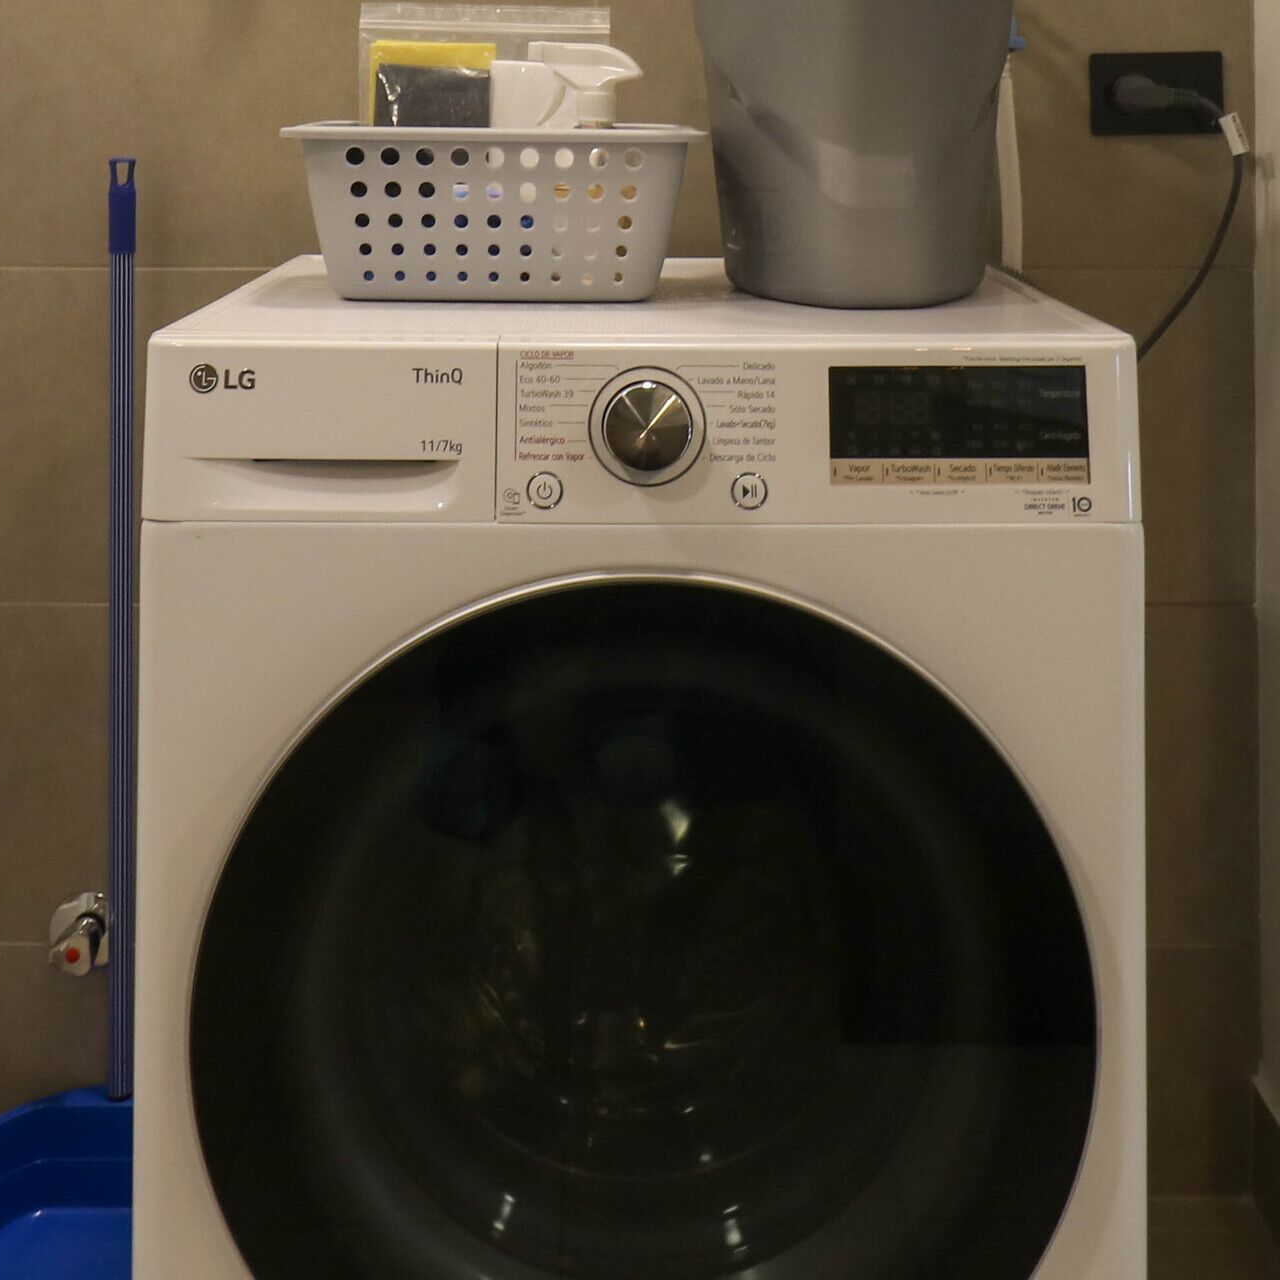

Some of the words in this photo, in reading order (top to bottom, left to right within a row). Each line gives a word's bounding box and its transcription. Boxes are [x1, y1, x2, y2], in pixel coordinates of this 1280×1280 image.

[520, 361, 552, 372] Algodón
[743, 362, 775, 371] Delicado
[223, 369, 256, 390] LG
[412, 367, 463, 385] ThinQ
[520, 375, 534, 384] Eco
[535, 375, 561, 384] 40-60
[697, 376, 724, 385] Lavado
[733, 376, 775, 385] Mano/Lana
[520, 389, 561, 398] TurboWash
[563, 389, 574, 398] 39
[737, 390, 764, 400] Rápido
[519, 404, 545, 413] Mixtos
[749, 404, 776, 414] Secado
[519, 418, 553, 428] Sintético
[519, 435, 566, 446] Antialérgico
[420, 439, 463, 455] 11/7kg
[709, 453, 744, 463] Descarga
[745, 453, 755, 462] de
[757, 453, 776, 462] Ciclo
[848, 463, 871, 474] Vapor
[890, 463, 932, 473] TurboWash
[949, 463, 977, 473] Secado
[1072, 496, 1092, 513] 10
